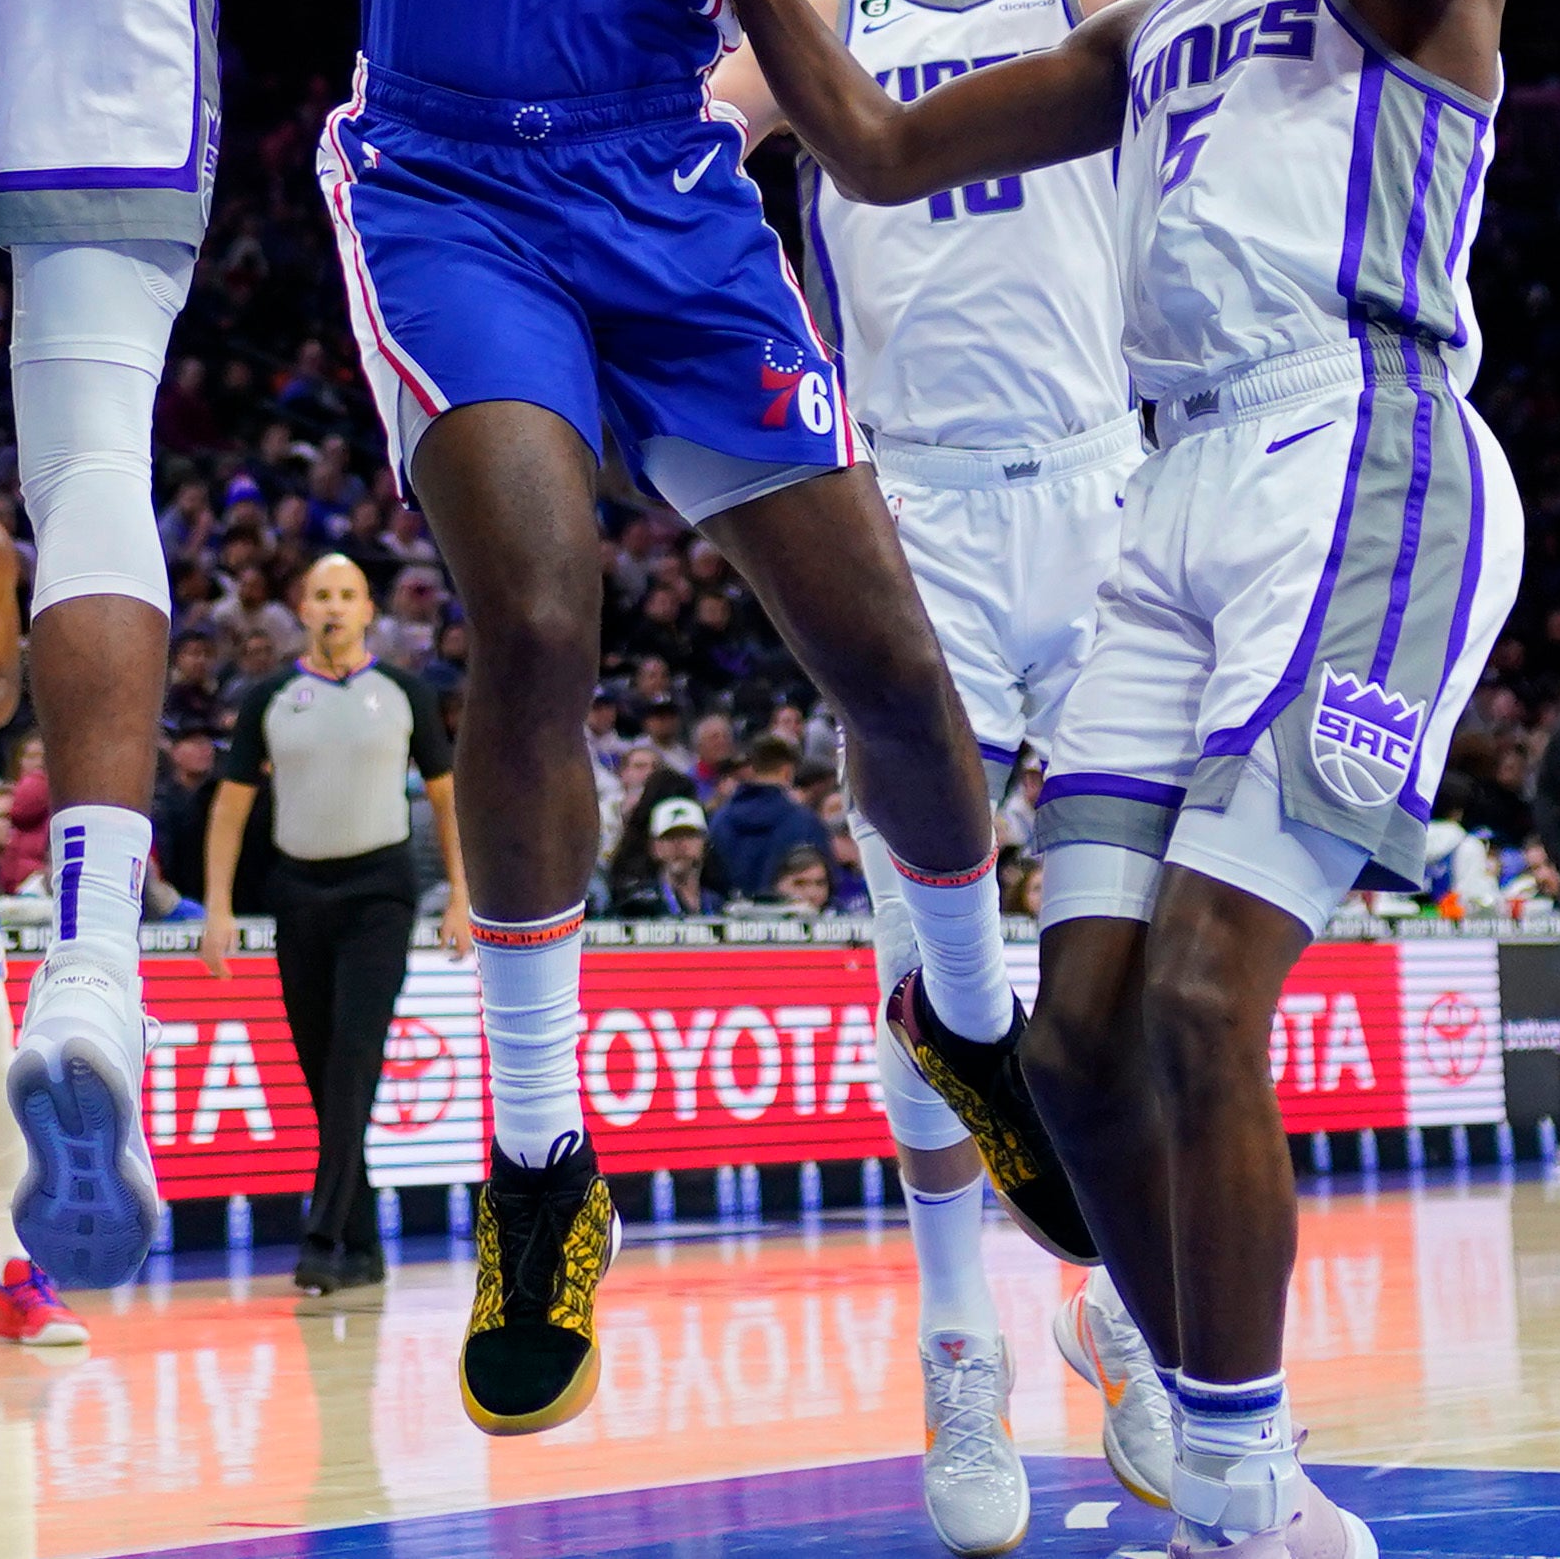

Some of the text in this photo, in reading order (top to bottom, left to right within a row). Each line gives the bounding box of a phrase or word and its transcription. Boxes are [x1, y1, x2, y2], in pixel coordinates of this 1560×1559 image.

[1158, 92, 1225, 202] 5
[761, 364, 833, 435] 76
[1317, 708, 1412, 771] SAC
[579, 1005, 886, 1127] OYOTA
